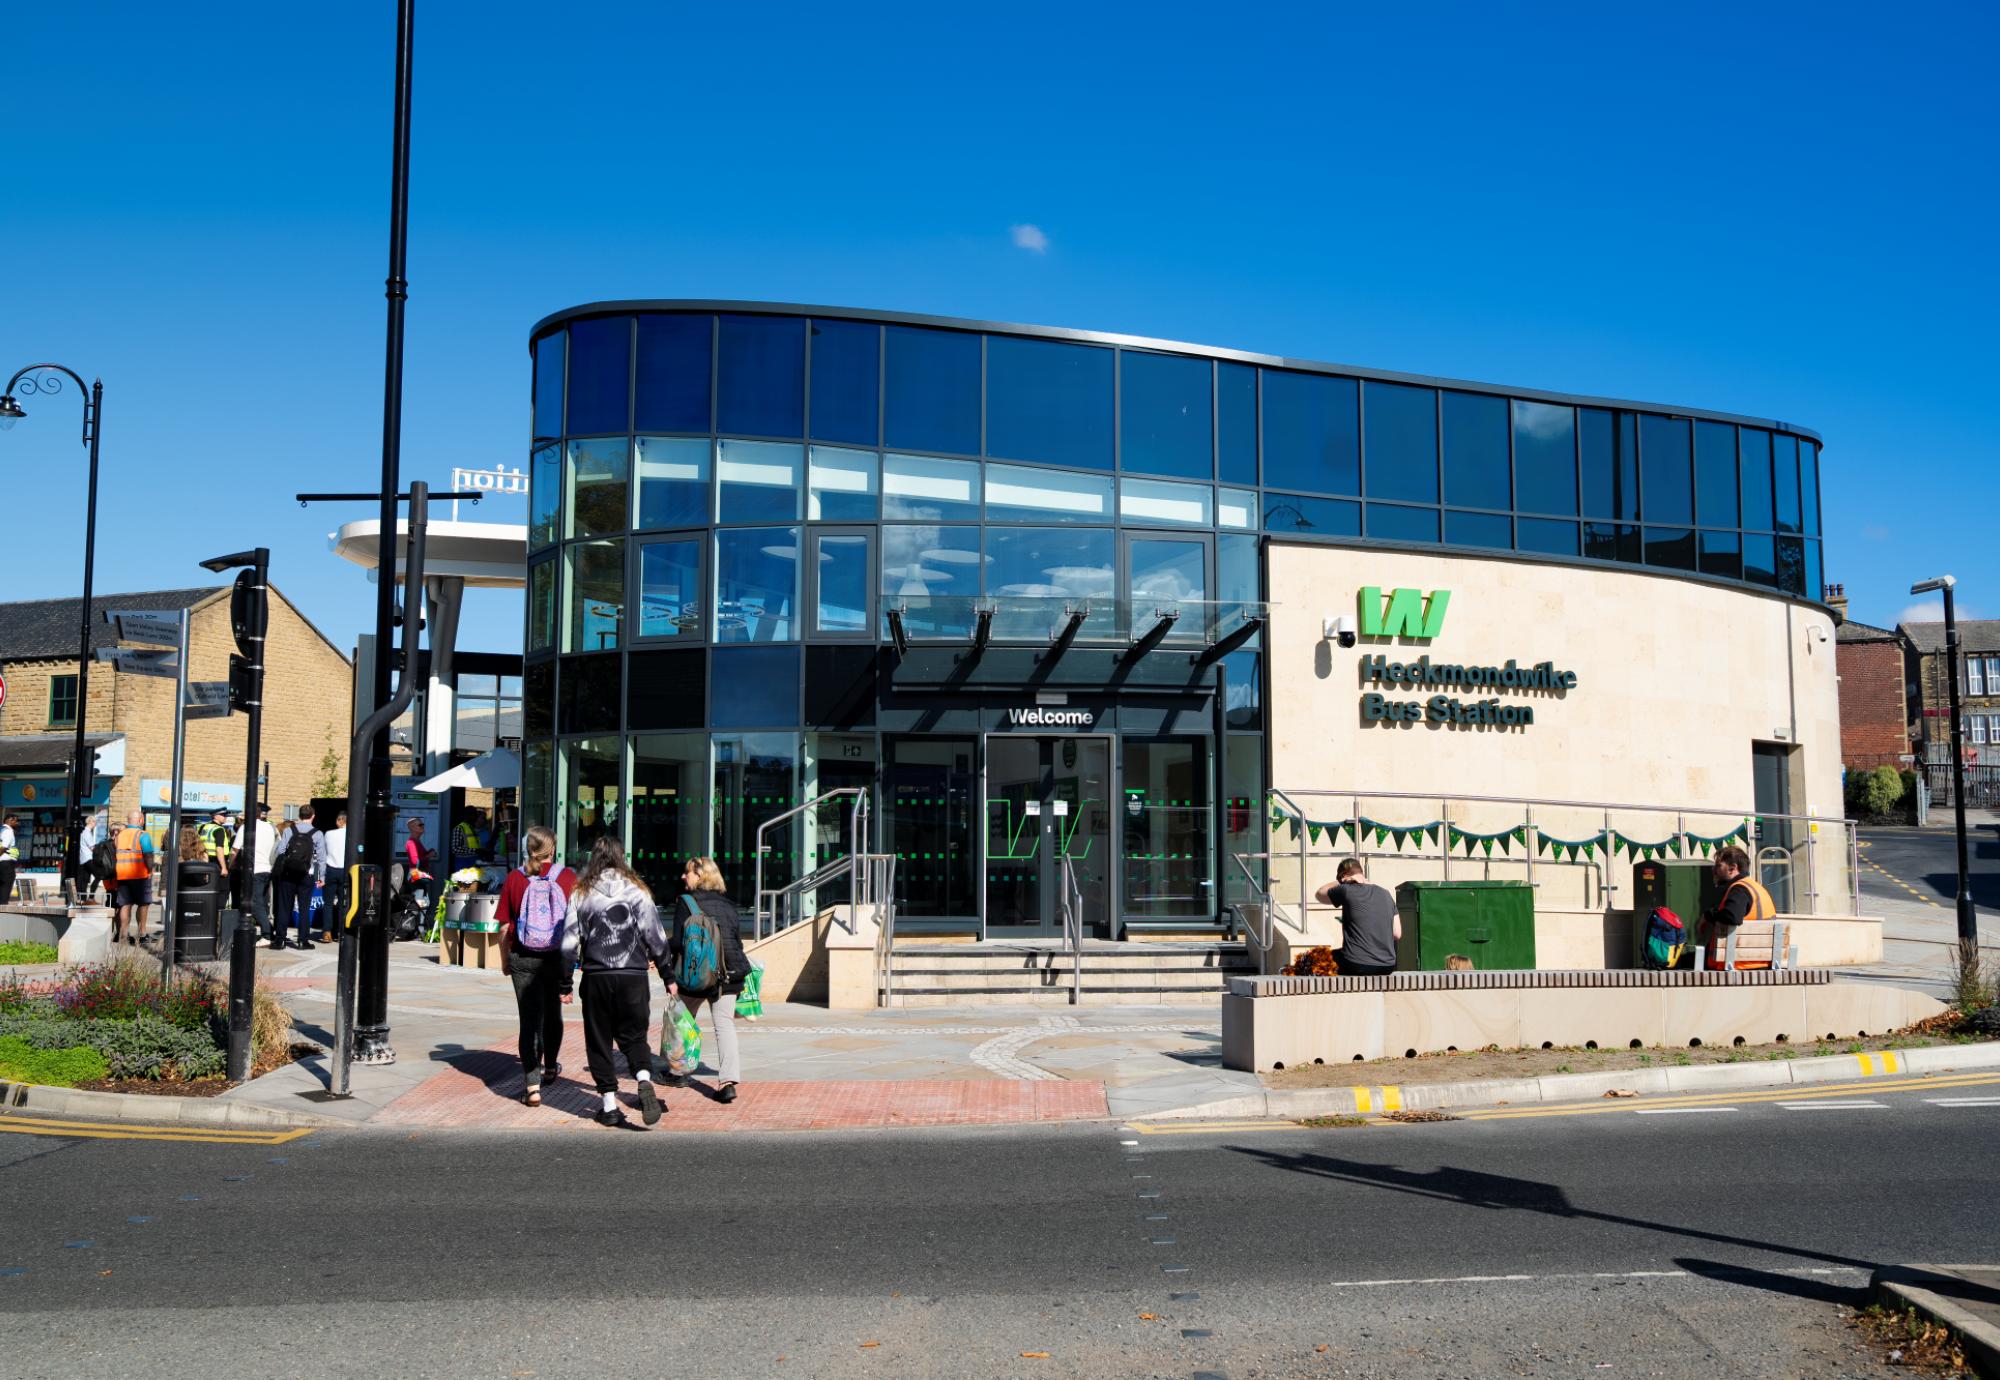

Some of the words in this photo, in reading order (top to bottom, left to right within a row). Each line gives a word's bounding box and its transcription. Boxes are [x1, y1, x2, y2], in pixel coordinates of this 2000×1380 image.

[1362, 653, 1578, 690] Heckmondwike
[1008, 707, 1094, 725] Welcome
[1363, 693, 1422, 721] Bus
[1426, 694, 1534, 725] Station
[183, 791, 201, 802] otal
